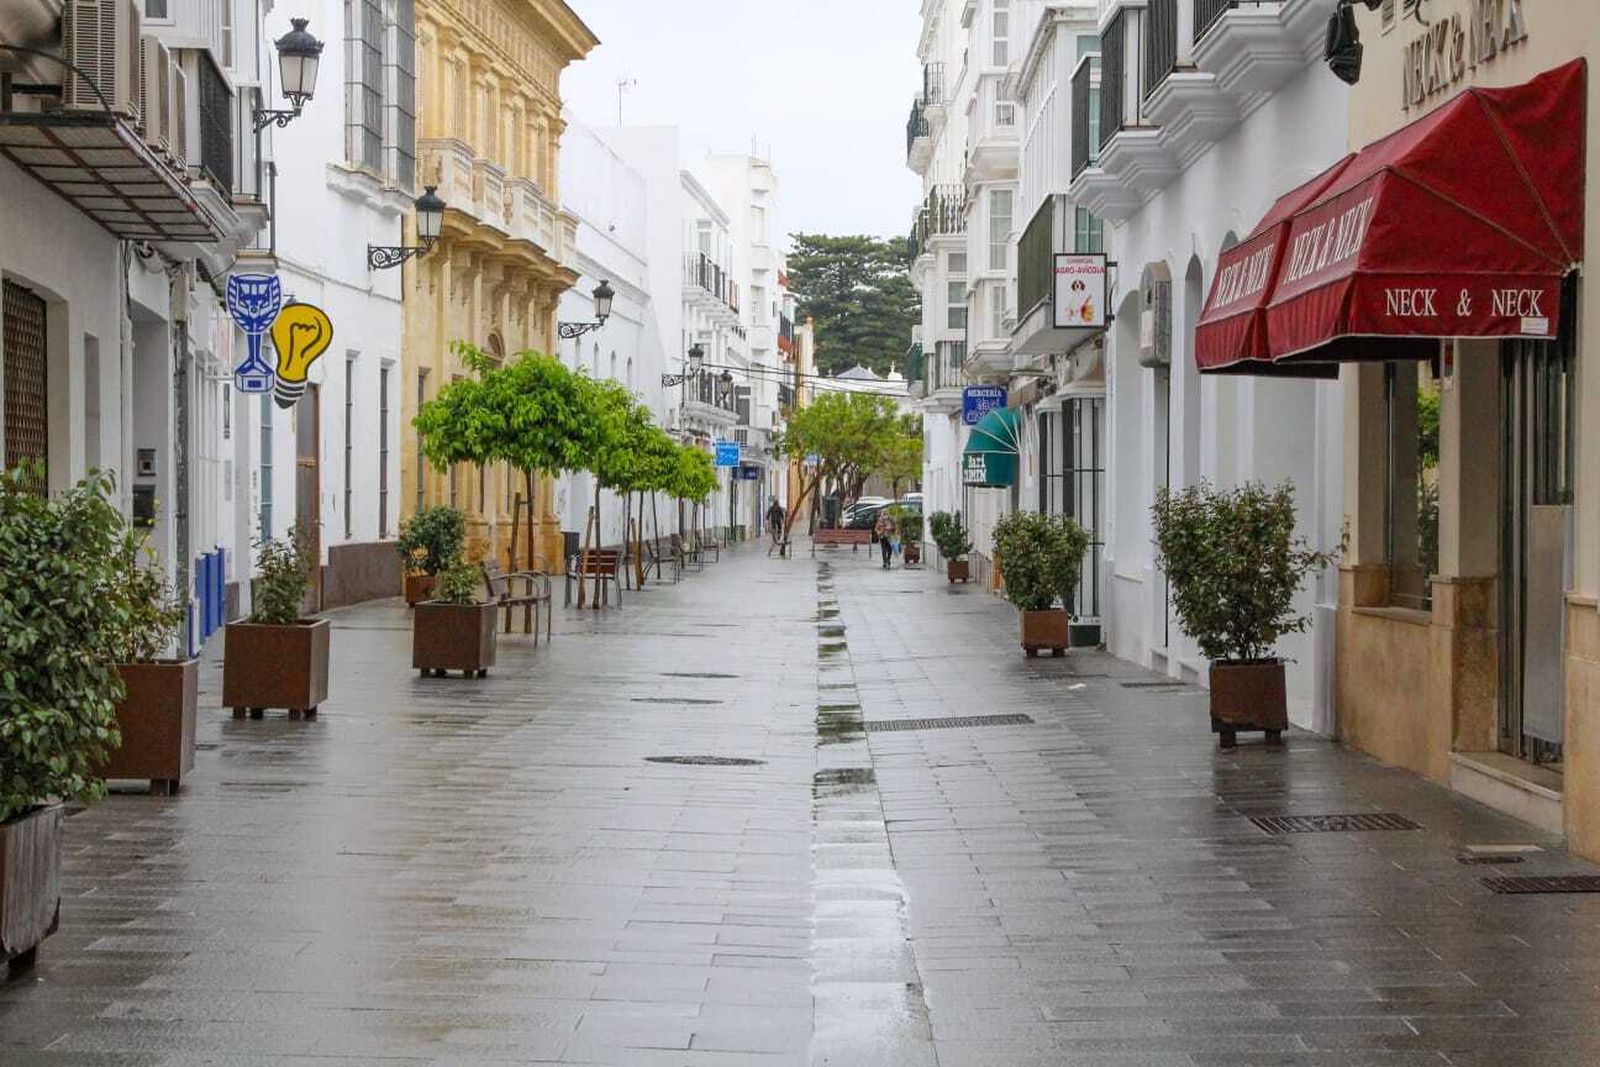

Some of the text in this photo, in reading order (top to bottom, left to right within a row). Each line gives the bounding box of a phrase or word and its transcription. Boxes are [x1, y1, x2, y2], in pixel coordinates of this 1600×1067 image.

[1401, 18, 1449, 111] NECK
[1284, 223, 1327, 284] NECK
[1328, 196, 1374, 265] NECK
[1385, 288, 1544, 317] NECK & NECK
